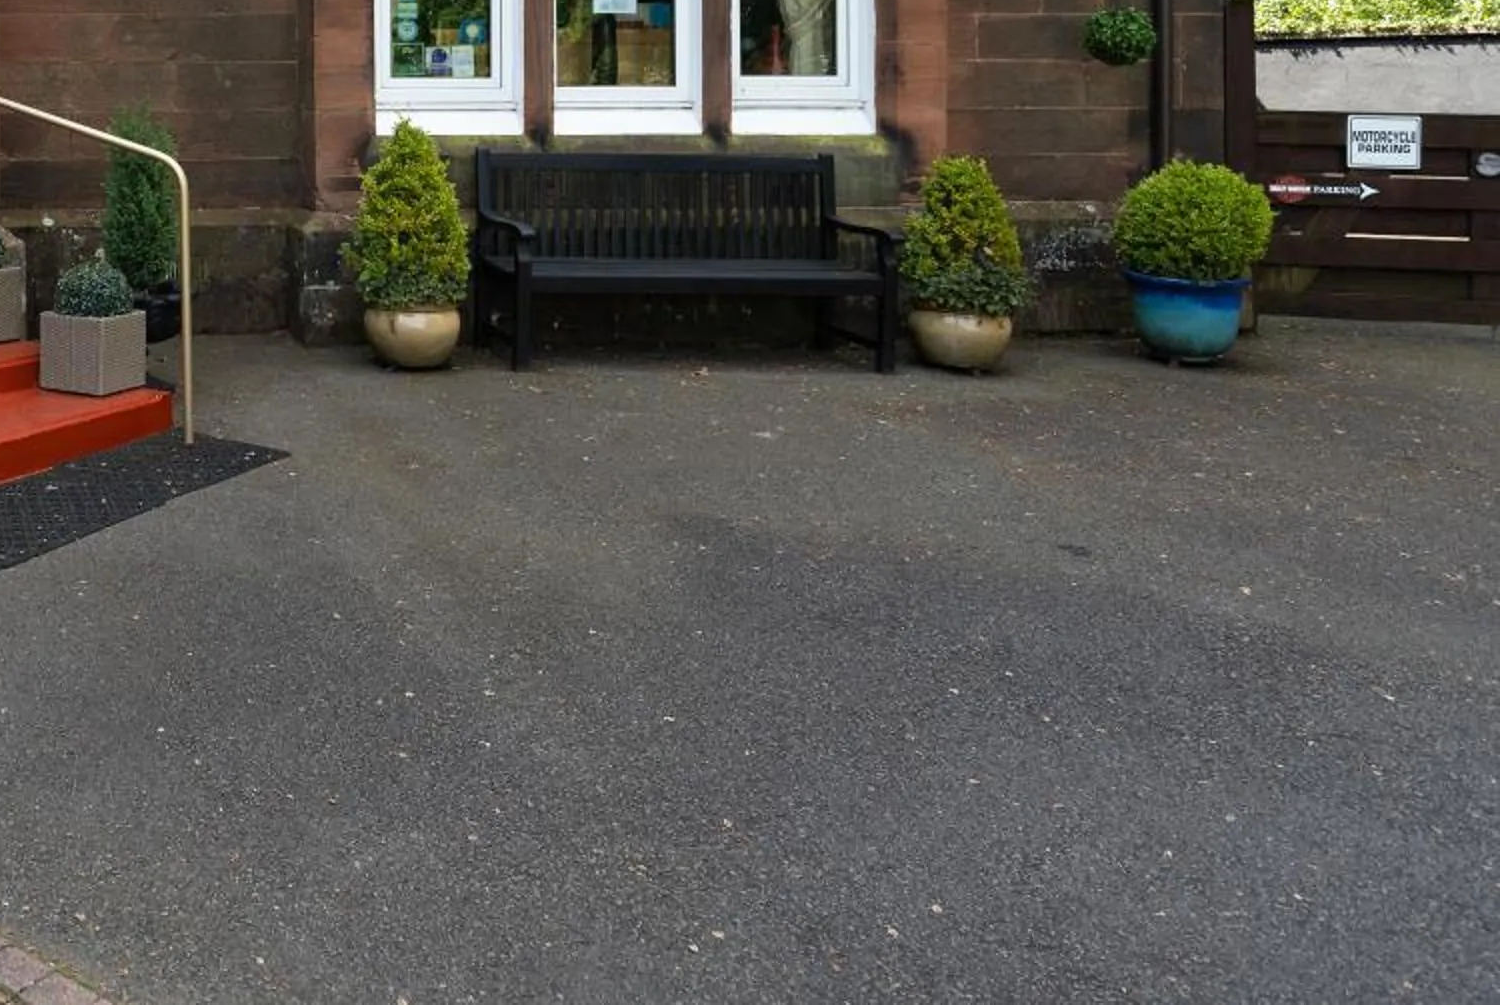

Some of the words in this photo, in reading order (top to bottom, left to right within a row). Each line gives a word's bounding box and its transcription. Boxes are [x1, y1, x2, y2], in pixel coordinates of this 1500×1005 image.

[1353, 130, 1417, 143] MOTORCYCLE
[1357, 143, 1411, 153] PARKING
[1313, 185, 1360, 194] PARKING
